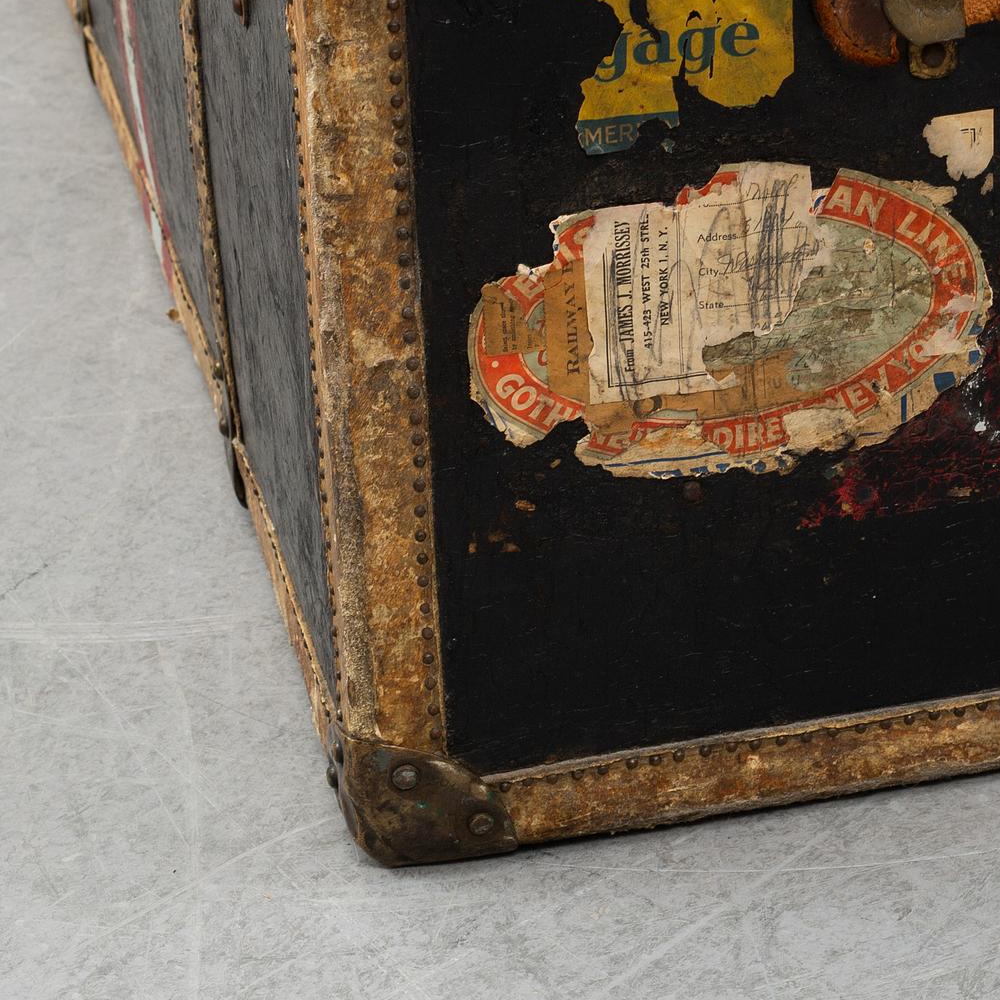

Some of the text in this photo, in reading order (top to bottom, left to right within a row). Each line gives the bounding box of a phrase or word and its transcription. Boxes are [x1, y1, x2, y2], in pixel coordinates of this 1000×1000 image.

[697, 232, 738, 244] Address
[897, 210, 968, 285] LINE
[640, 247, 651, 269] 25th
[614, 221, 635, 373] From JAMES J. MORRISSEY
[640, 275, 651, 305] WEST
[658, 268, 669, 297] YORK
[659, 300, 669, 326] NEW
[566, 281, 580, 377] RAILWAY
[642, 309, 653, 350] 415-423
